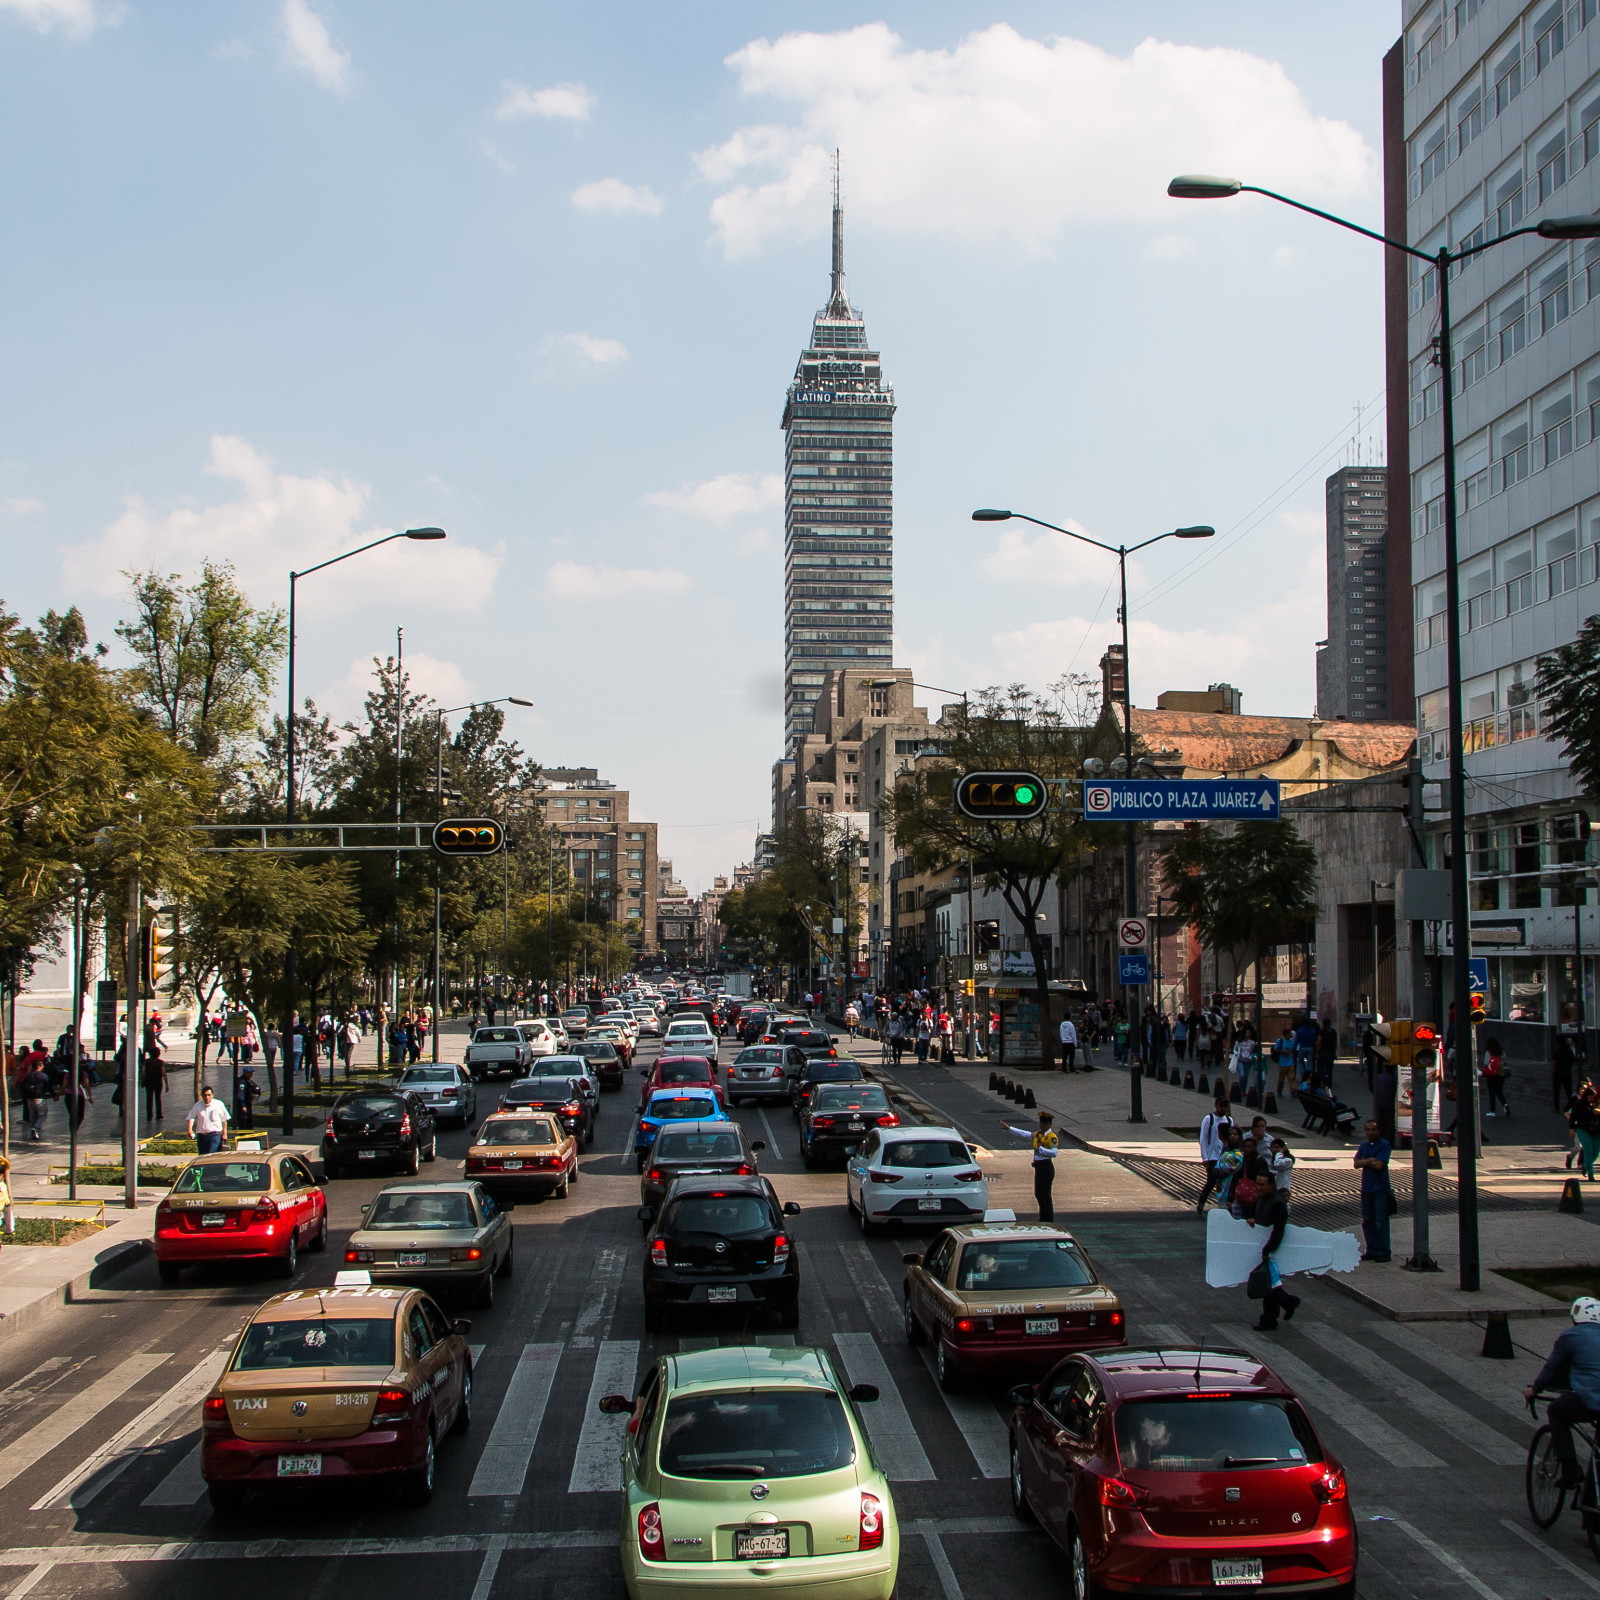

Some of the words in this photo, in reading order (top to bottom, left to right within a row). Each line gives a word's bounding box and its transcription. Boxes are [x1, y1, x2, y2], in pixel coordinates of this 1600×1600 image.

[820, 362, 863, 372] SEGUROS
[796, 393, 831, 403] LATINO
[1112, 785, 1163, 808] PÚBLICO
[1168, 791, 1208, 808] PLAZA
[1211, 786, 1257, 808] JUÁREZ
[974, 962, 988, 971] 015
[283, 1291, 304, 1301] B
[995, 1303, 1025, 1314] TAXI
[233, 1398, 267, 1410] TAXI
[335, 1393, 369, 1405] B-31-276
[281, 1459, 318, 1470] B-31-276
[738, 1537, 787, 1550] MAG-67-20
